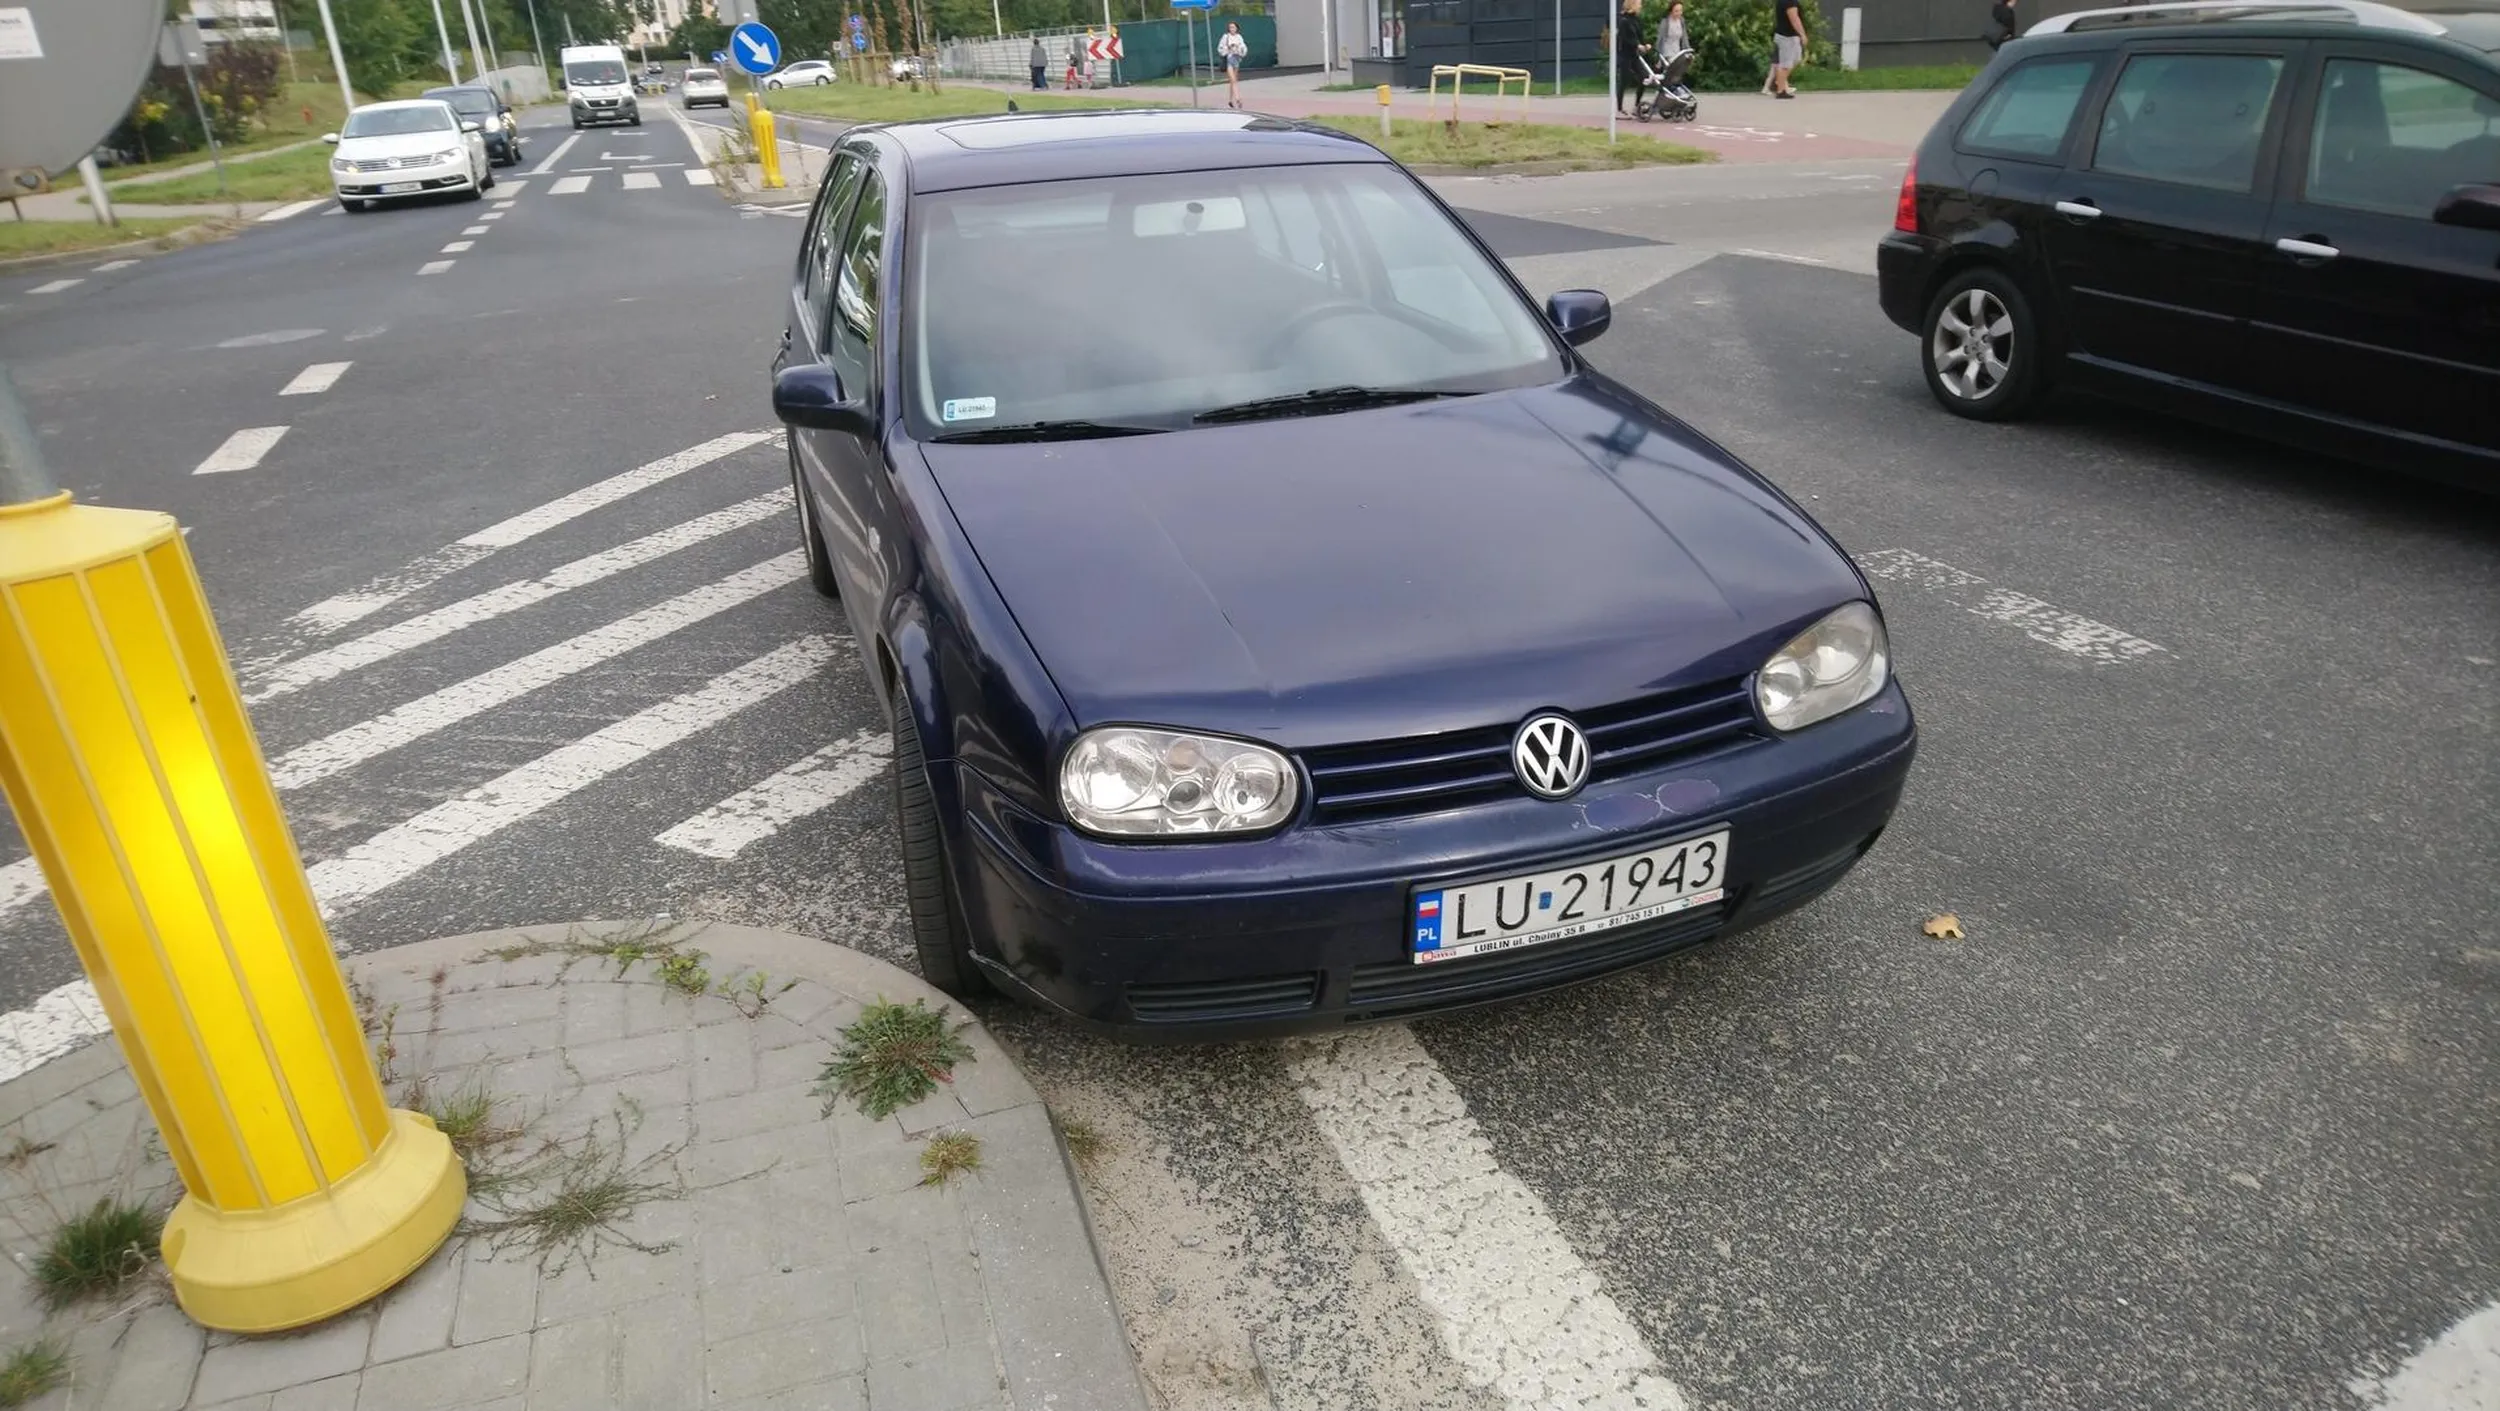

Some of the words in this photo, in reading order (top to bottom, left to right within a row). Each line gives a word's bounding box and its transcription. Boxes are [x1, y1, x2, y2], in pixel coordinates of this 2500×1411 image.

[1456, 881, 1534, 940] LU
[1557, 840, 1718, 922] 21943
[1417, 927, 1438, 942] PL
[1473, 939, 1510, 953] LUBLIN
[1564, 926, 1577, 936] 35
